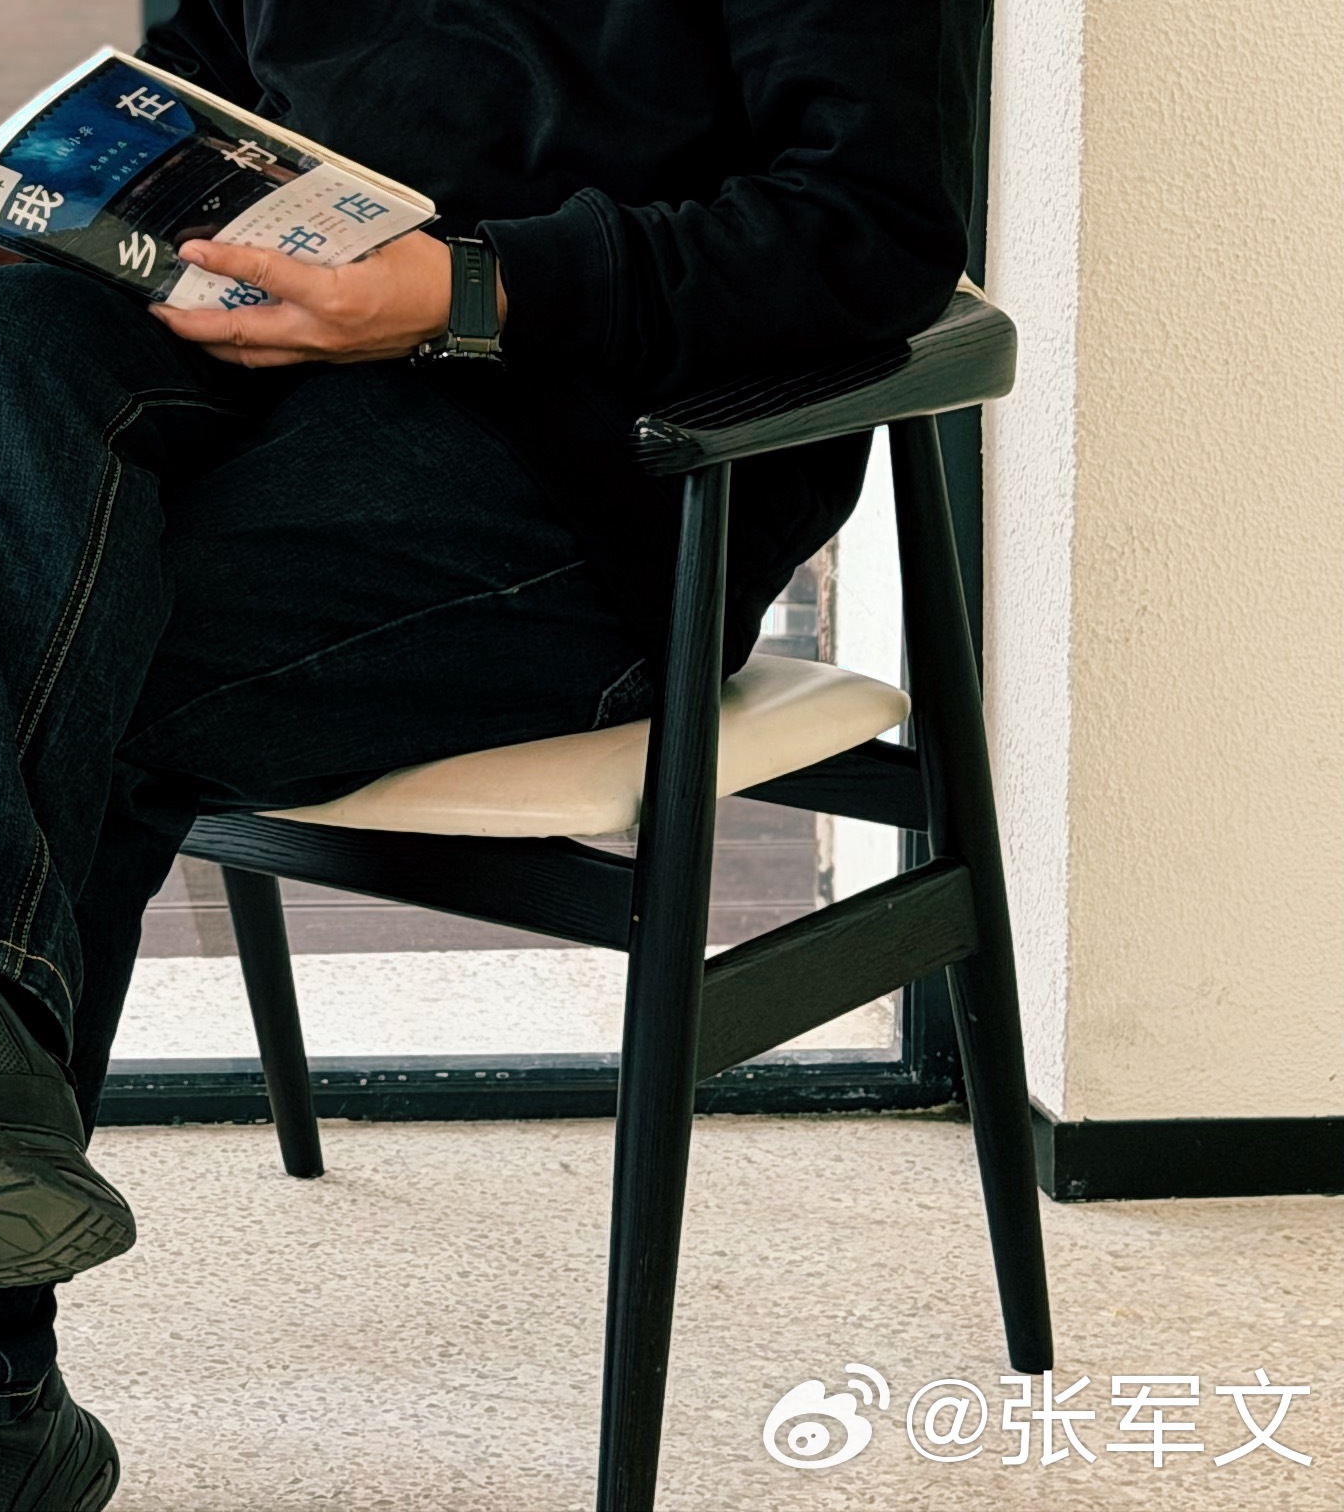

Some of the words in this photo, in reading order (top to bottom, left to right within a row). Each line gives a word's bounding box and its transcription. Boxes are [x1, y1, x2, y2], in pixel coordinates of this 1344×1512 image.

[6, 184, 64, 234] 我
[115, 86, 177, 121] 在
[221, 138, 277, 172] 村
[332, 192, 390, 224] 店
